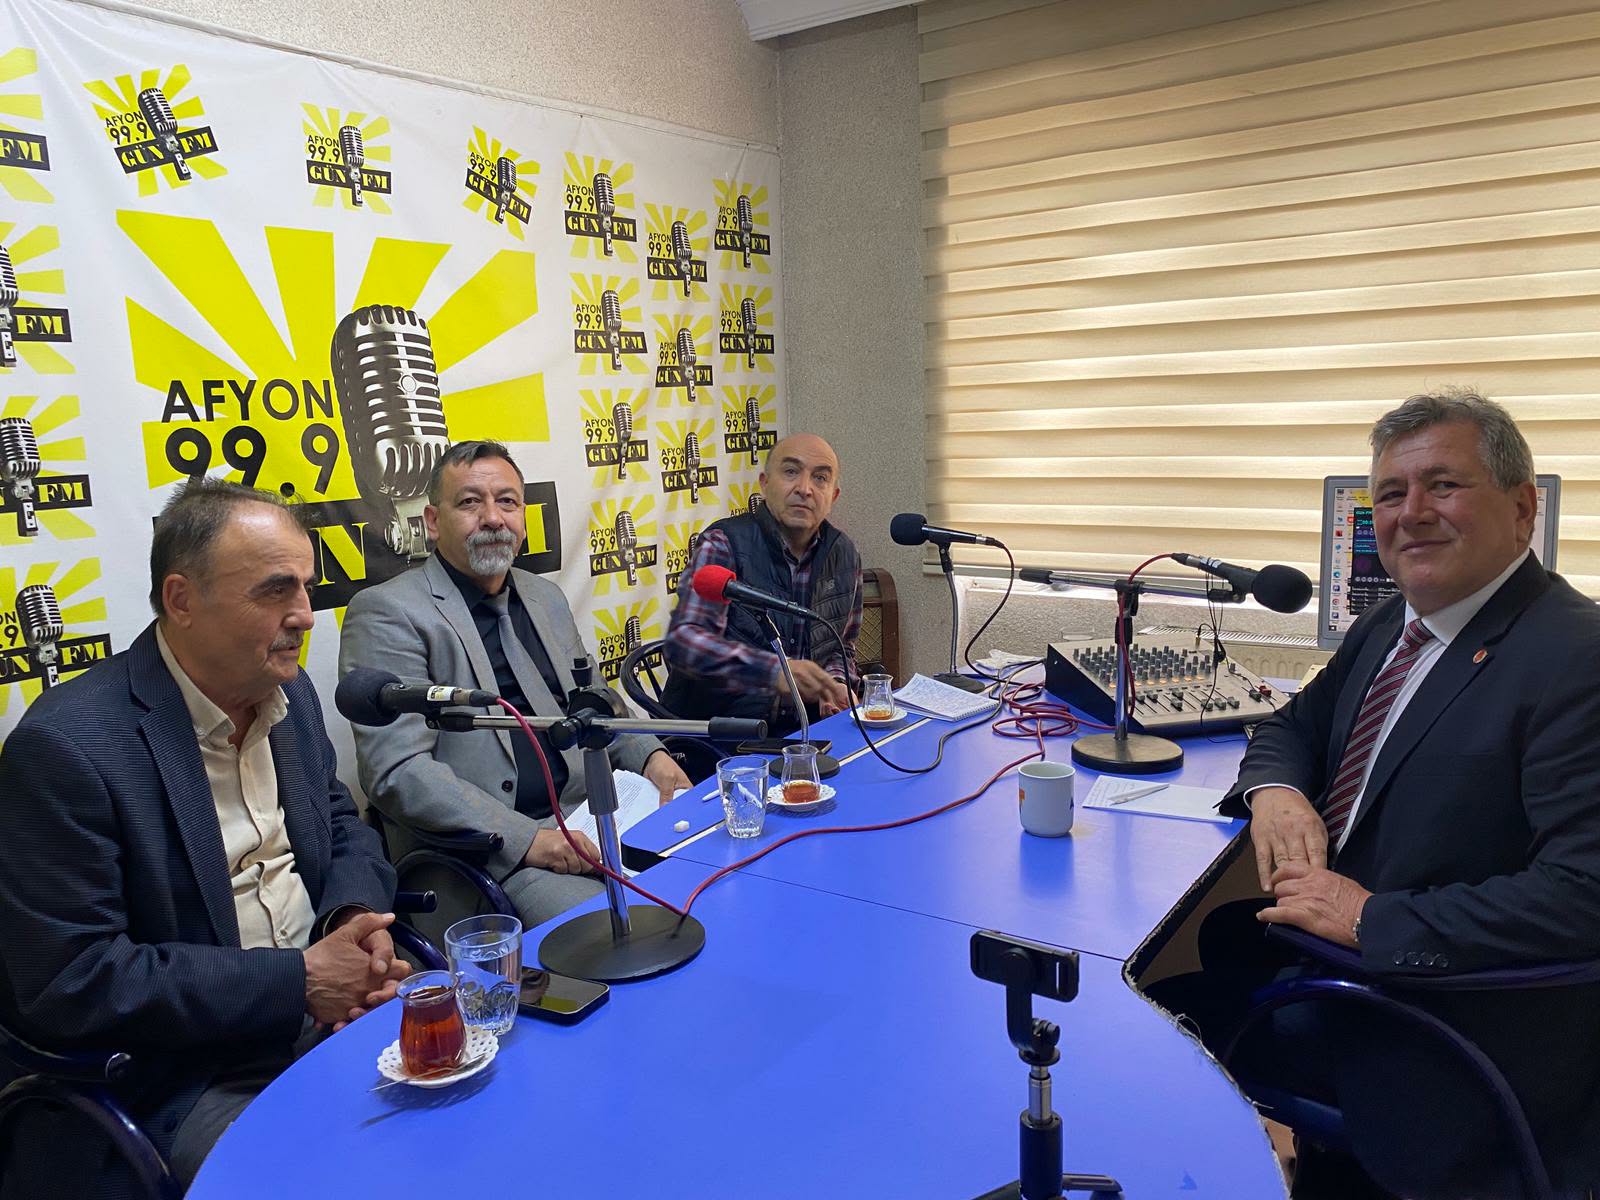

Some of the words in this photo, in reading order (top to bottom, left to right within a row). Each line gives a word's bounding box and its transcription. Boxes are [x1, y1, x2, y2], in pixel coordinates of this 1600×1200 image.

[105, 111, 143, 128] AFYON
[110, 122, 148, 145] 99.9
[307, 135, 340, 148] AFYON
[121, 144, 164, 167] GÜN
[179, 133, 212, 153] FM
[308, 144, 340, 163] 99.9
[470, 152, 497, 170] AFYON
[309, 164, 346, 183] GÜN
[361, 173, 389, 189] FM
[470, 159, 497, 181] 99.9
[566, 184, 593, 196] AFYON
[567, 194, 594, 212] 99.9
[567, 214, 599, 233] GÜN
[613, 221, 634, 237] FM
[648, 233, 671, 243] AFYON
[715, 232, 740, 248] GÜN
[751, 237, 768, 250] FM
[649, 242, 672, 257] 99.9
[649, 260, 678, 276] GÜN
[576, 304, 602, 313] AFYON
[721, 310, 741, 318] AFYON
[16, 314, 64, 335] FM
[576, 313, 602, 329] 99.9
[721, 319, 741, 332] 99.9
[620, 336, 643, 349] FM
[721, 335, 745, 349] GÜN
[755, 338, 772, 350] FM
[660, 351, 676, 365] 99.9
[161, 379, 334, 423] AFYON
[585, 419, 614, 428] AFYON
[726, 419, 746, 432] 99.9
[586, 427, 615, 442] 99.9
[726, 435, 749, 449] GÜN
[758, 434, 775, 447] FM
[627, 444, 646, 458] FM
[164, 423, 340, 497] 99.9
[662, 456, 685, 470] 99.9
[699, 470, 715, 484] FM
[36, 482, 85, 503] FM
[590, 528, 615, 539] AFYON
[591, 536, 616, 553] 99.9
[600, 634, 625, 646] AFYON
[60, 641, 107, 666] FM
[601, 642, 625, 660] 99.9
